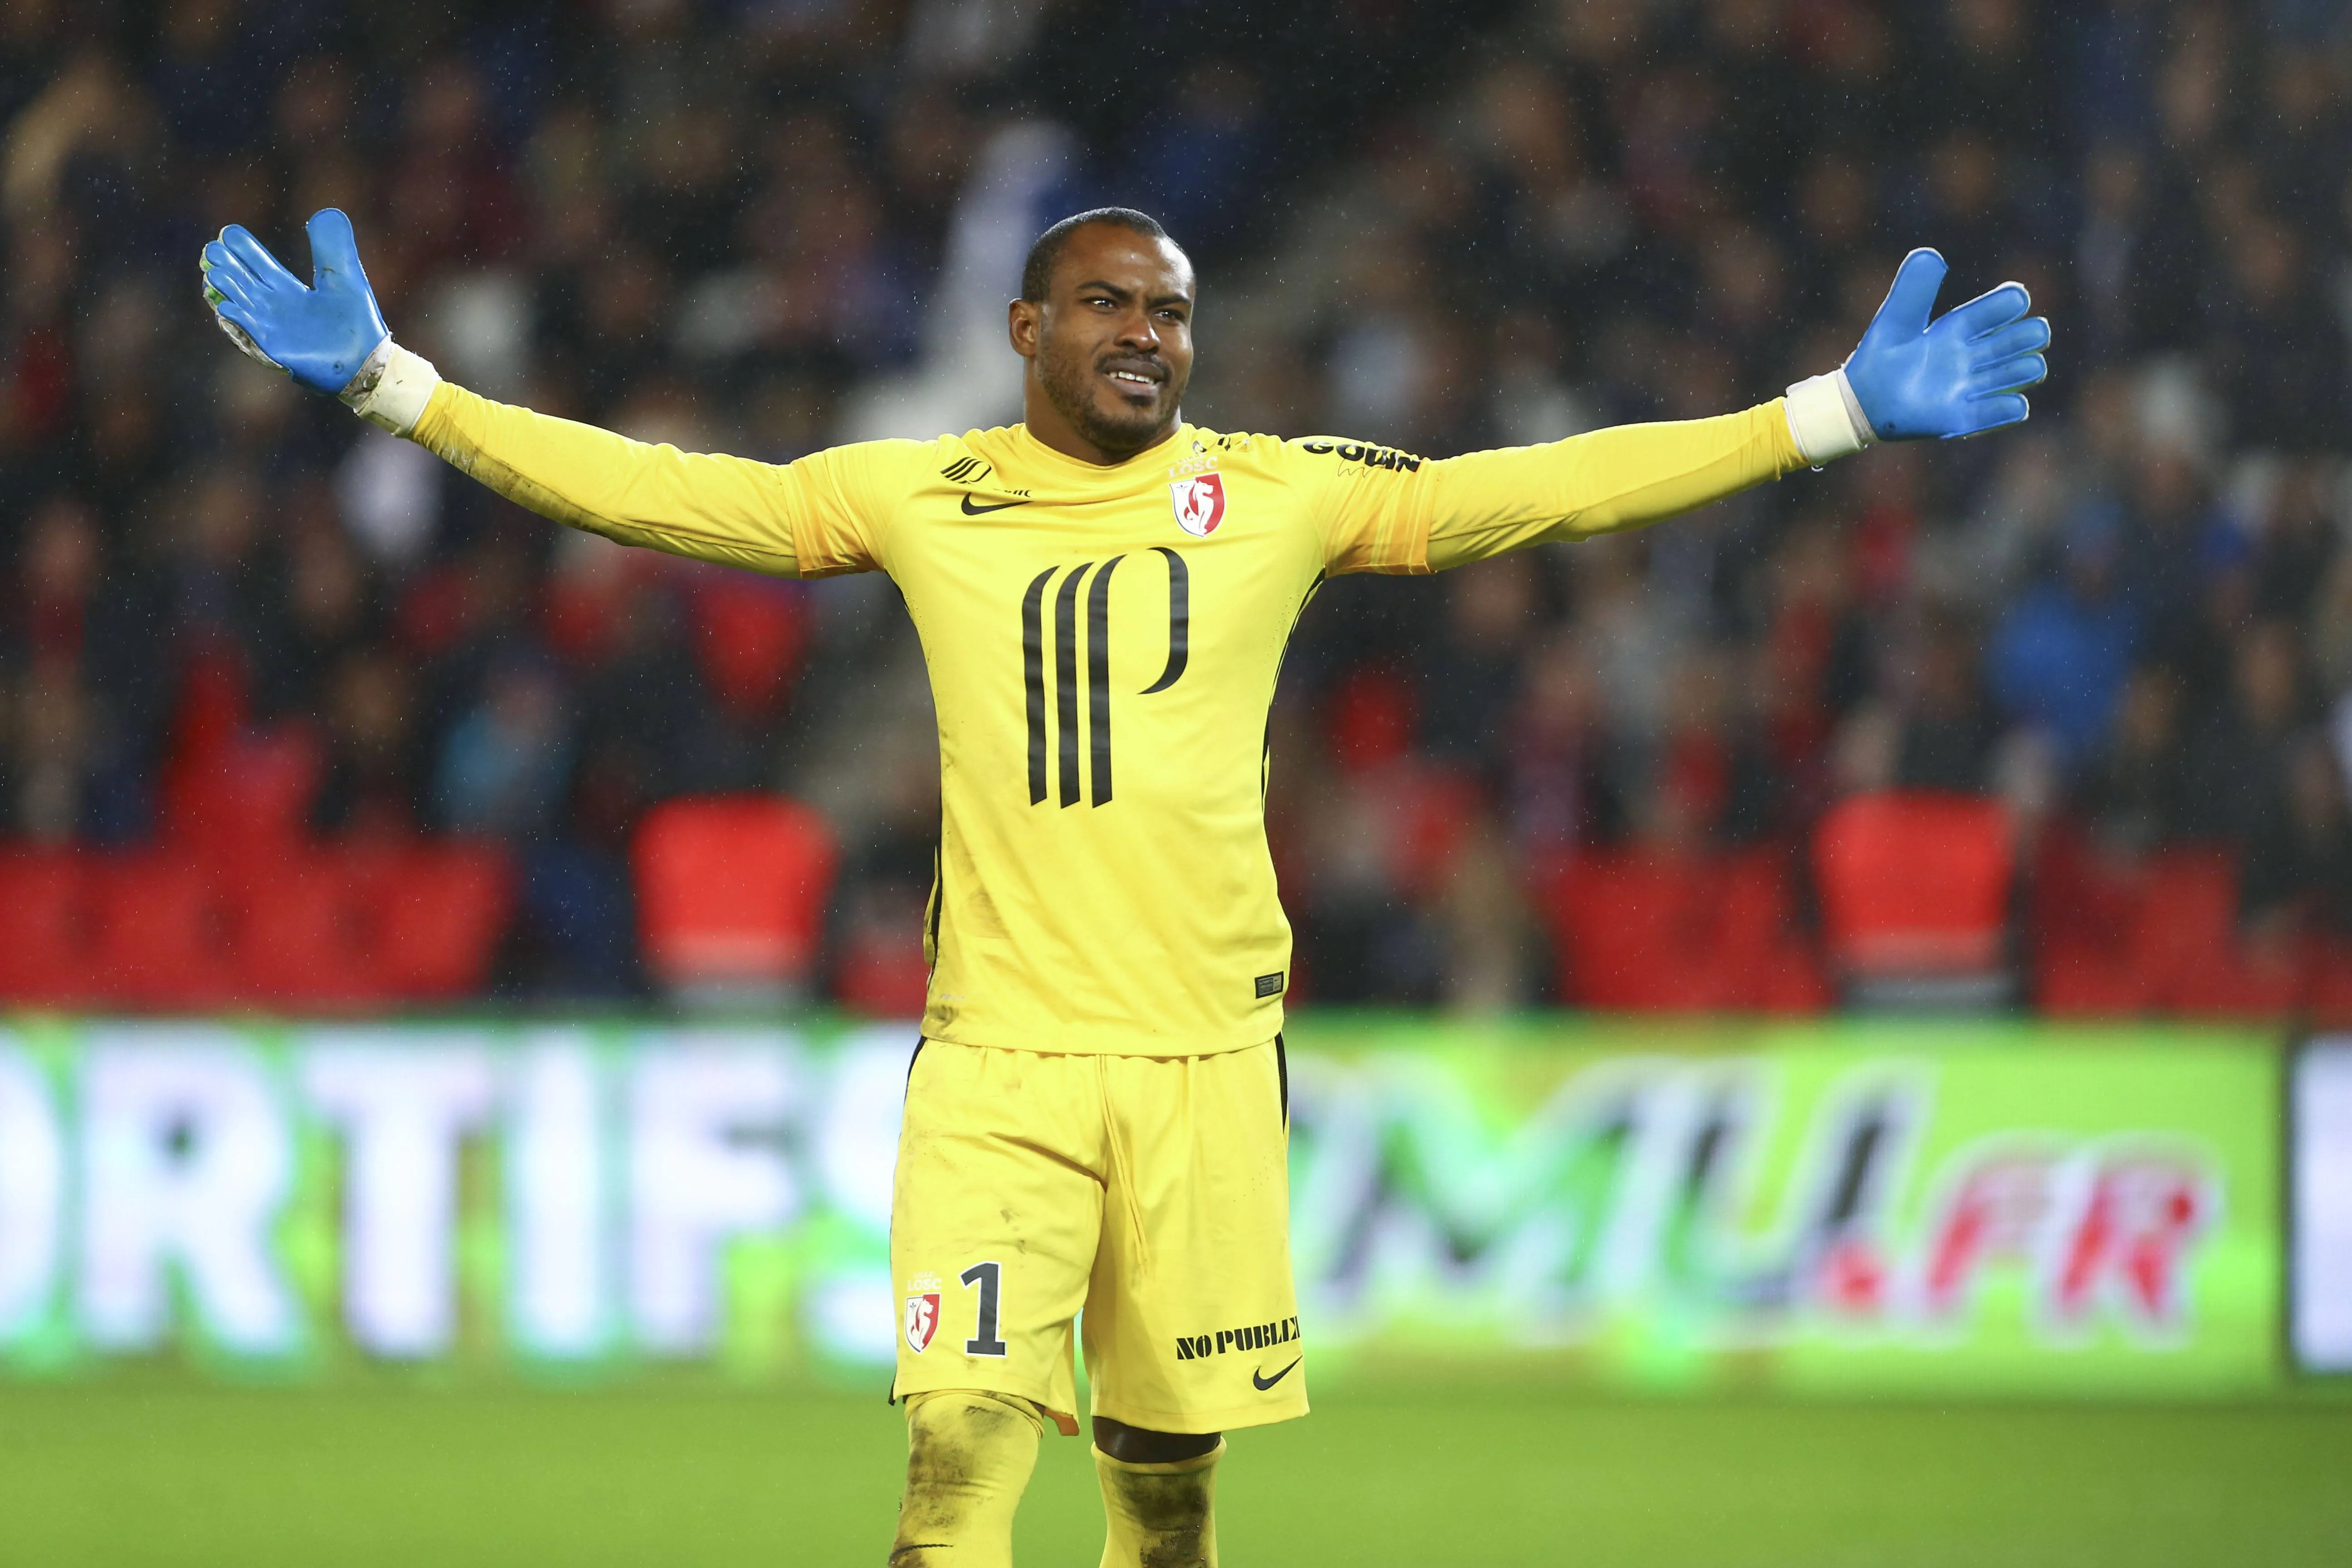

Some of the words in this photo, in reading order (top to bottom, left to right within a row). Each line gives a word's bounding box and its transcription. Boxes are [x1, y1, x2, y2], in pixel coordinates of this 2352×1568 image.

[1168, 456, 1219, 479] LOSC
[1286, 1064, 2219, 1336] MU.FR
[907, 1277, 942, 1291] LOSC
[959, 1260, 1007, 1357] 1
[1176, 1335, 1212, 1360] NO
